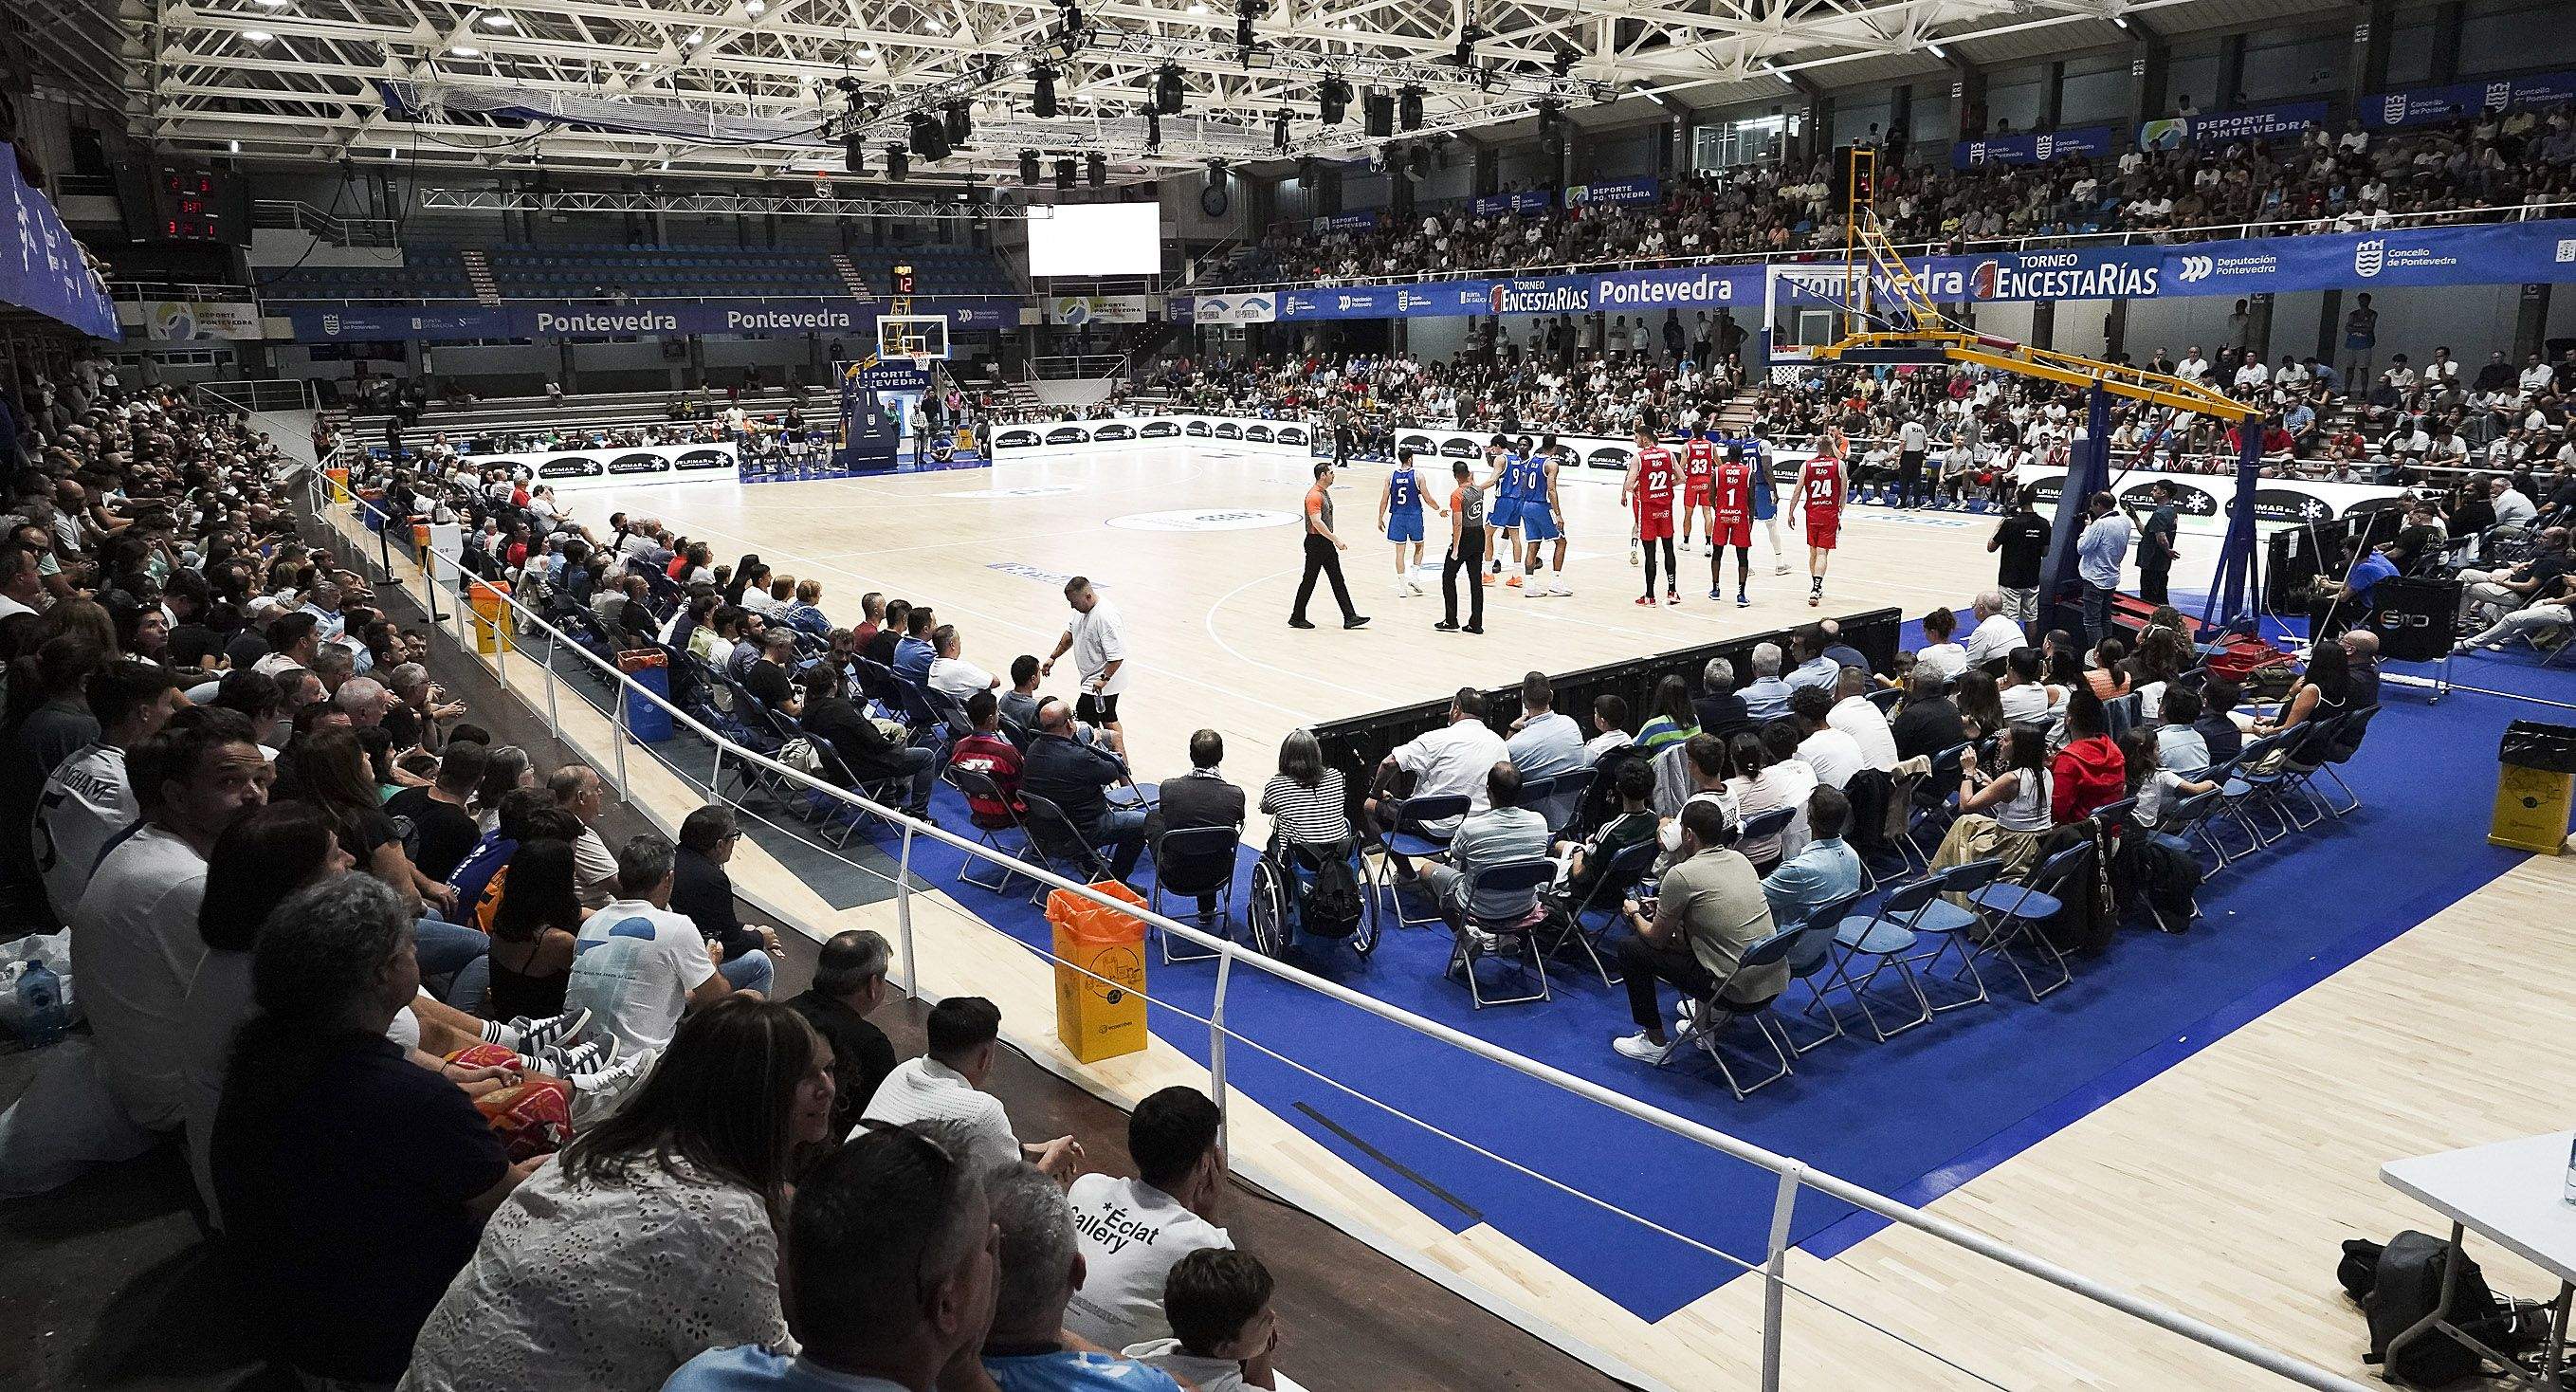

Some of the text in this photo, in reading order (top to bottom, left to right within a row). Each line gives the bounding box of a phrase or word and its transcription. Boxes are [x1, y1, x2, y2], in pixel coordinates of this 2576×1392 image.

[2197, 114, 2275, 130] DEPORTE
[1593, 185, 1633, 195] DEPORTE
[1593, 191, 1651, 202] POTEVEDRA
[2019, 253, 2078, 268] TORNEO
[2217, 254, 2276, 267] Deputación
[2386, 255, 2457, 267] de Pontevedra
[2387, 247, 2431, 260] Concello
[2216, 264, 2276, 276] Pontevedra
[900, 277, 912, 292] 12
[1513, 280, 1545, 291] TORNEO
[1599, 273, 1732, 303] Pontevedra
[1791, 264, 1964, 298] Ponvedra
[1996, 262, 2159, 299] ENCESTARÍAS
[1501, 285, 1589, 312] ENCESTARÍAS
[538, 309, 677, 332] Pontevedra
[727, 307, 850, 329] Pontevedra
[865, 378, 925, 388] TEVEDRA
[1690, 458, 1708, 475] 33
[1512, 467, 1520, 485] 9
[1527, 470, 1537, 490] 0
[1648, 470, 1668, 491] 22
[1397, 486, 1407, 505] 5
[1726, 487, 1736, 507] 1
[1810, 479, 1833, 499] 24
[1472, 504, 1482, 515] 82
[2226, 502, 2285, 512] JIMAR
[49, 762, 109, 801] LINGHAM
[1072, 1205, 1129, 1255] allery
